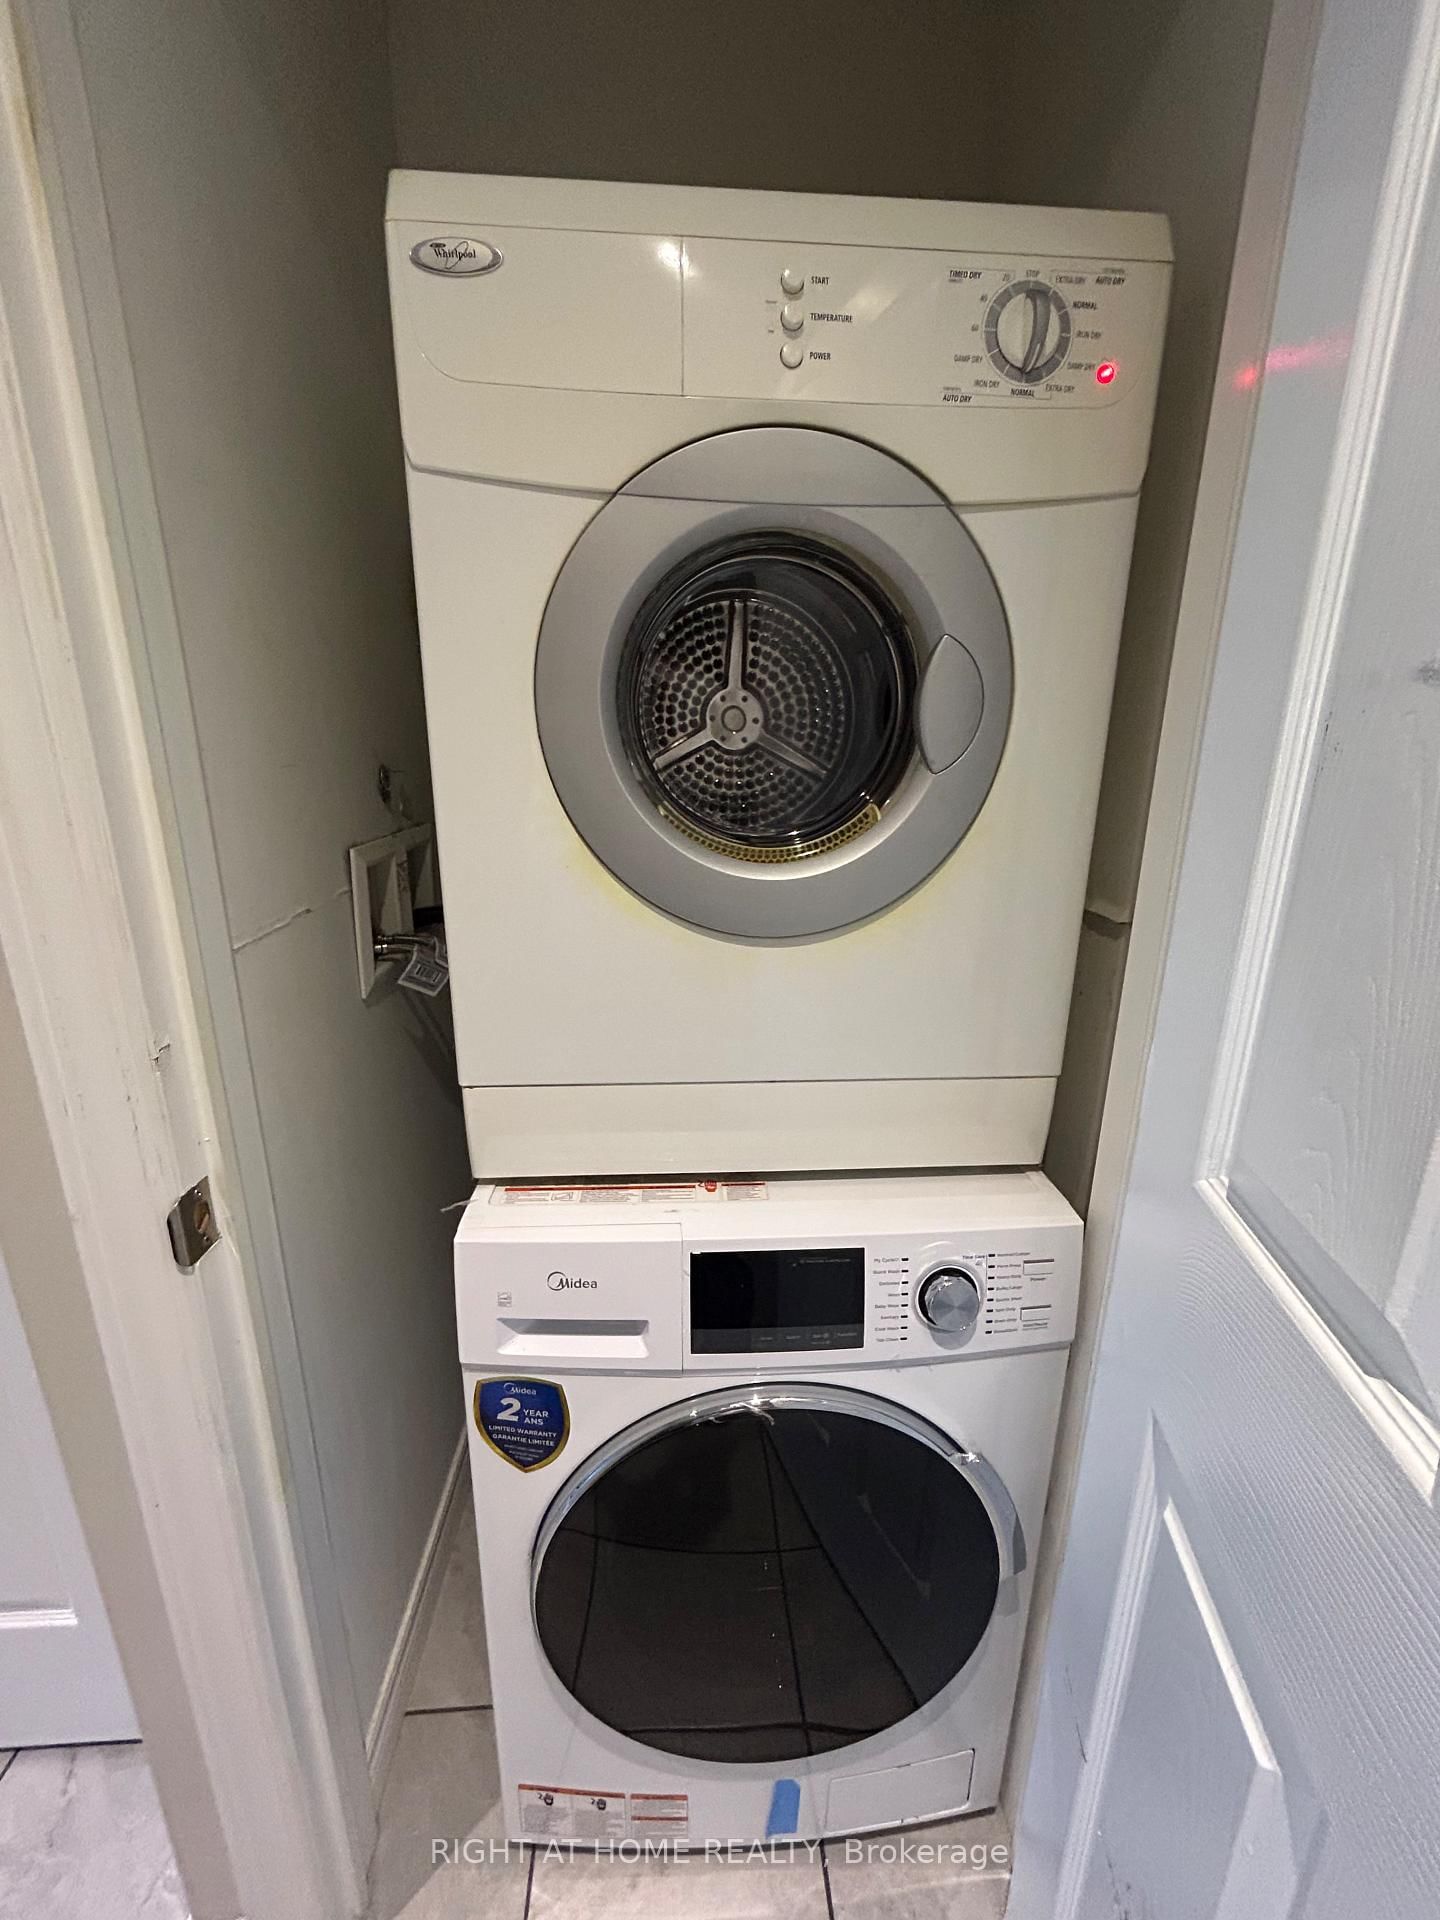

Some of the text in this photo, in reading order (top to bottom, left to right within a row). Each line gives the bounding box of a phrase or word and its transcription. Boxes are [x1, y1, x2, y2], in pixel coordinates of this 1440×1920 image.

[433, 247, 476, 262] Whirlpool
[949, 269, 982, 279] TIMED DRY
[811, 276, 829, 286] START
[1095, 275, 1125, 286] AUTO DRY
[1073, 301, 1097, 311] NORMAL
[810, 313, 853, 323] TEMPERATURE
[809, 351, 831, 361] POWER
[1010, 388, 1034, 398] NORMAL
[942, 394, 972, 403] AUTO DRY
[547, 1271, 597, 1291] Midea
[503, 1382, 537, 1395] Midea
[496, 1397, 549, 1422] 2 YEAR
[523, 1417, 544, 1426] ANS
[488, 1425, 557, 1438] LIMITED WARRANTY
[492, 1433, 527, 1443] GARANTIE
